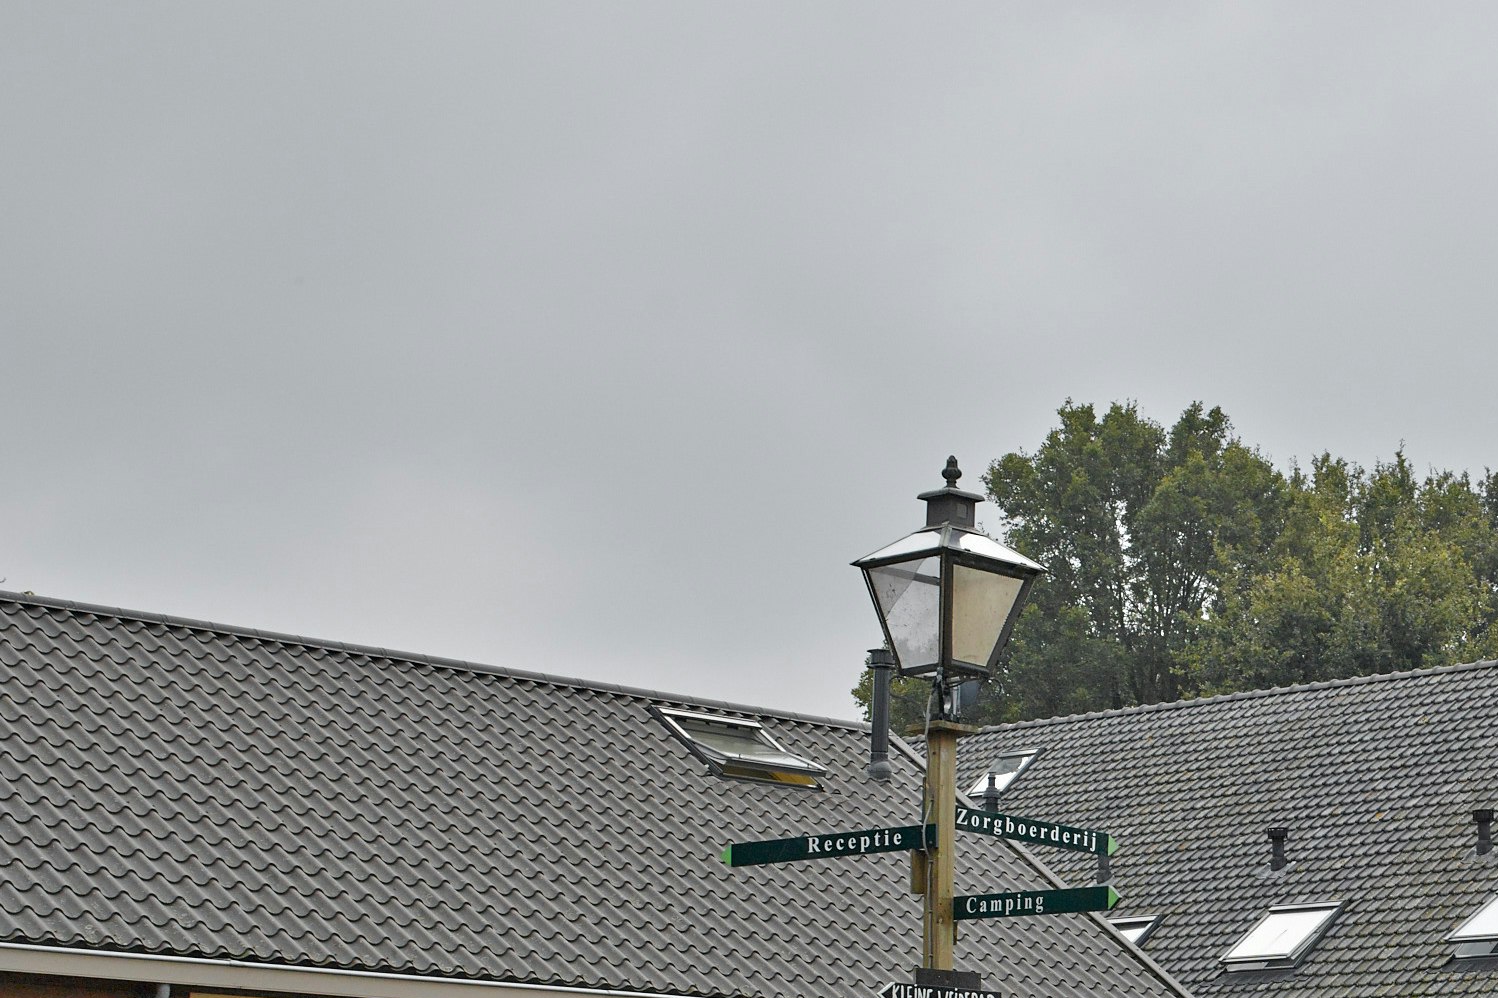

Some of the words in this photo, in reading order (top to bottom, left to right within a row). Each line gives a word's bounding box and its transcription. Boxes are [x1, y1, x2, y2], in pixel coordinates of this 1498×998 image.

[807, 829, 903, 853] Receptie
[956, 808, 1097, 852] Zorgboerderij
[966, 893, 1044, 916] Camping
